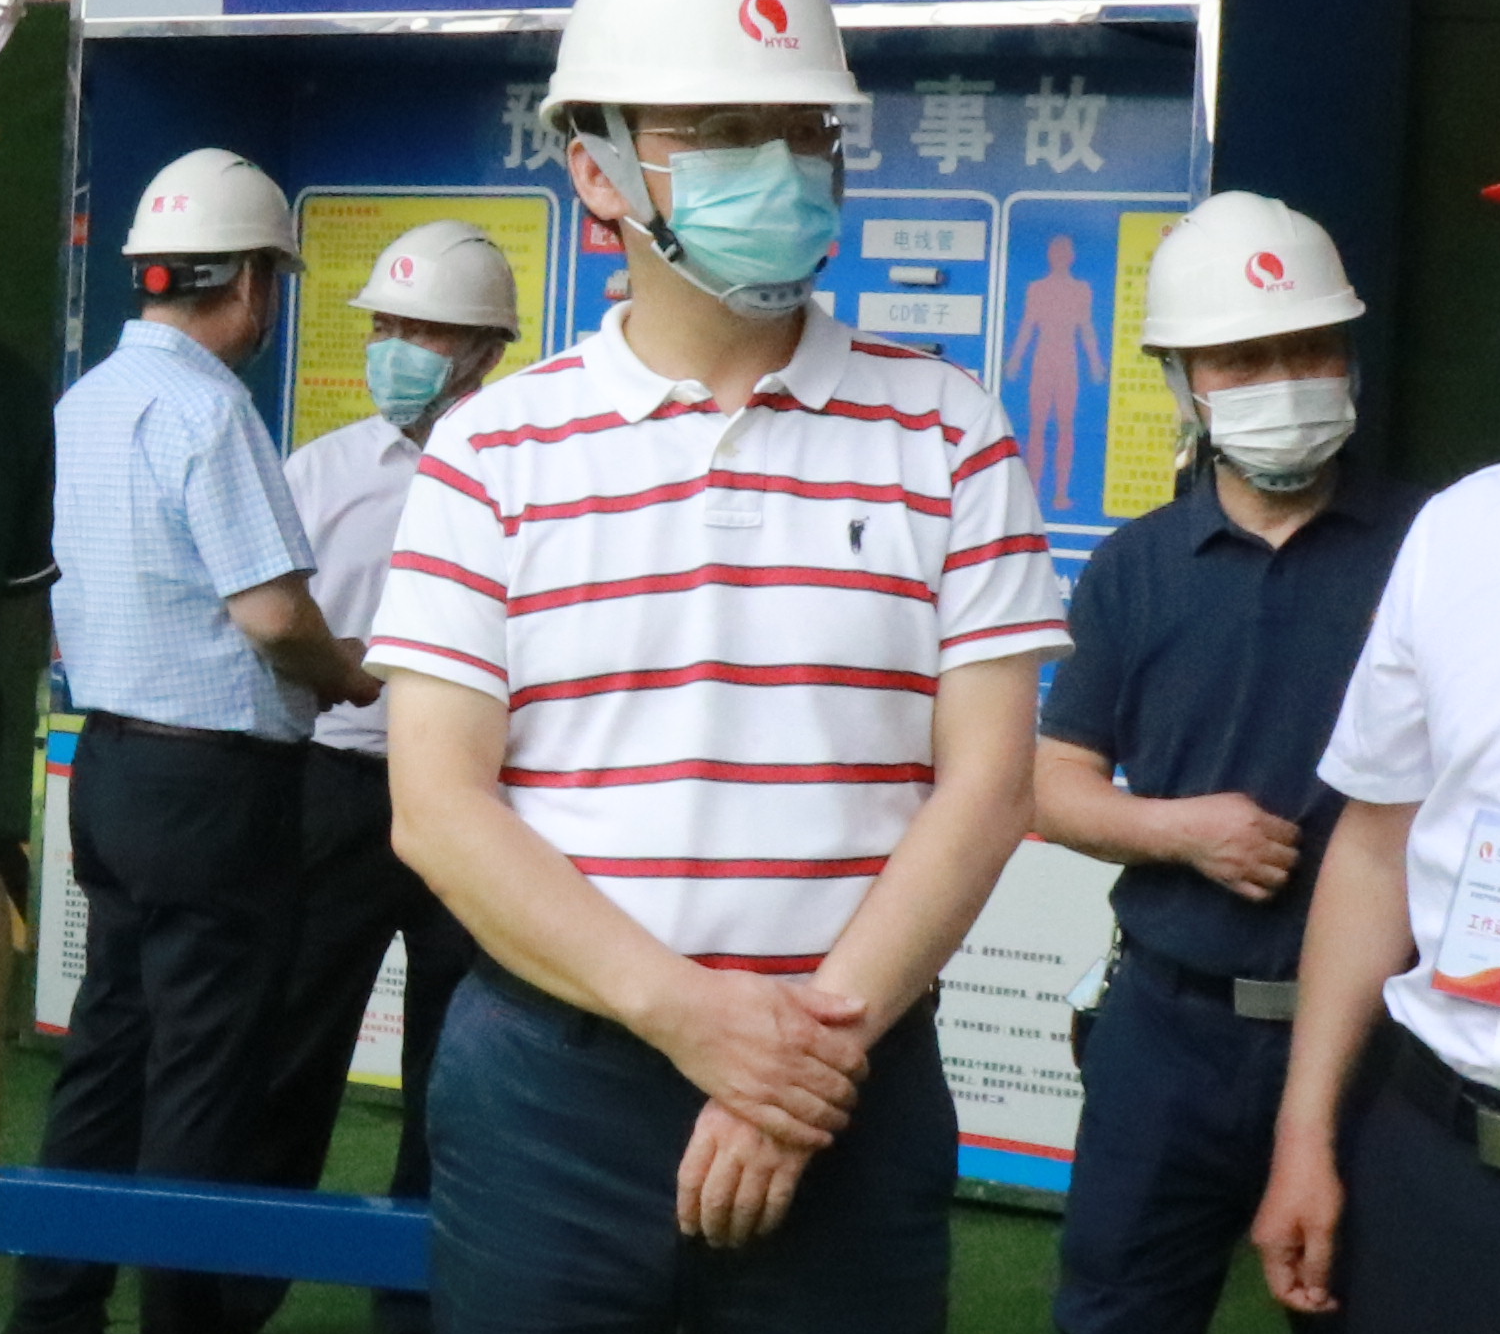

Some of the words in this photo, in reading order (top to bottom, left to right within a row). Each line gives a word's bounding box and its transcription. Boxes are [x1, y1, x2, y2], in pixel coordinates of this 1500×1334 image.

[765, 37, 800, 50] HYSZ
[151, 195, 190, 214] 嘉宾
[893, 228, 955, 252] 电线管
[888, 302, 952, 324] CD管子
